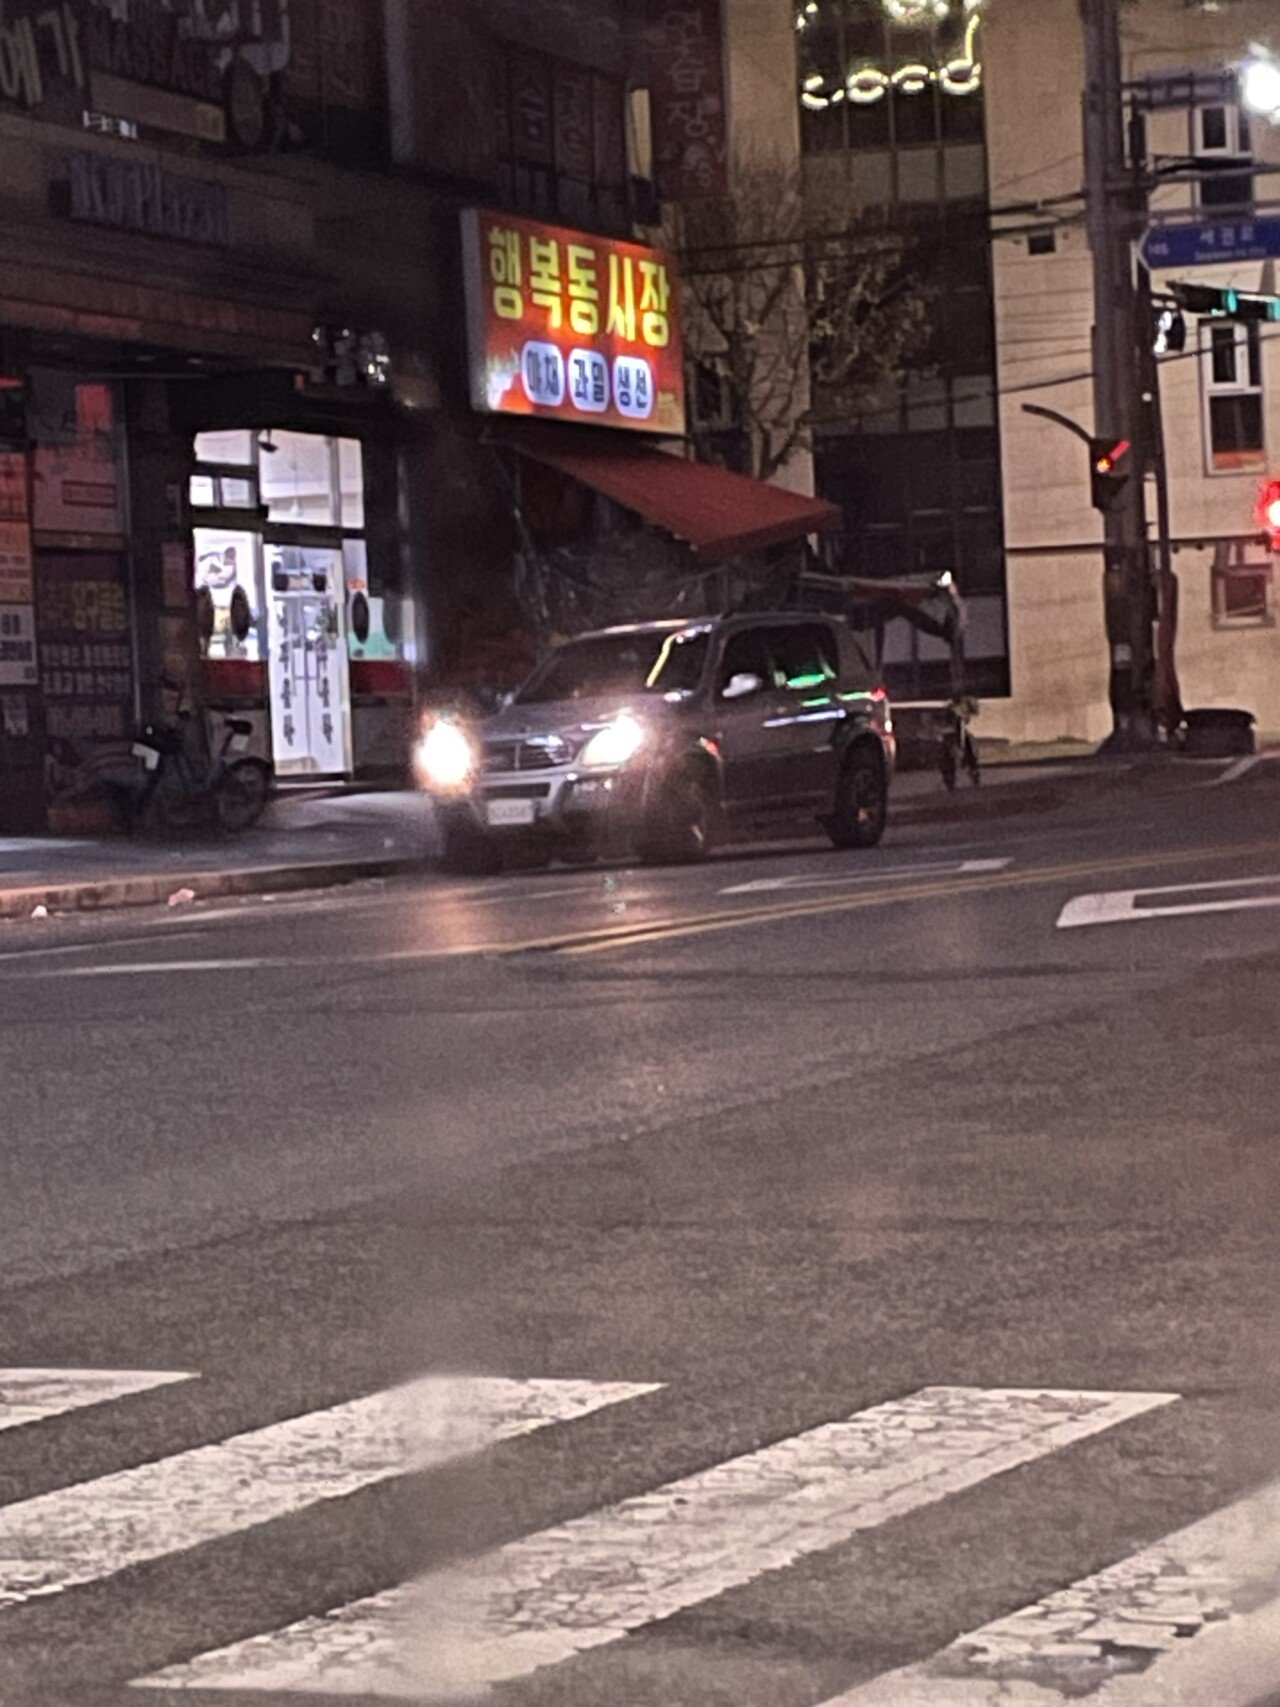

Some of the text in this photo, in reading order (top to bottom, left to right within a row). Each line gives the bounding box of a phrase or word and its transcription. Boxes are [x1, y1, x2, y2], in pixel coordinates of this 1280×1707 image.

[489, 226, 671, 347] 행복동시장
[573, 358, 606, 404] 과일
[618, 365, 650, 410] 생선
